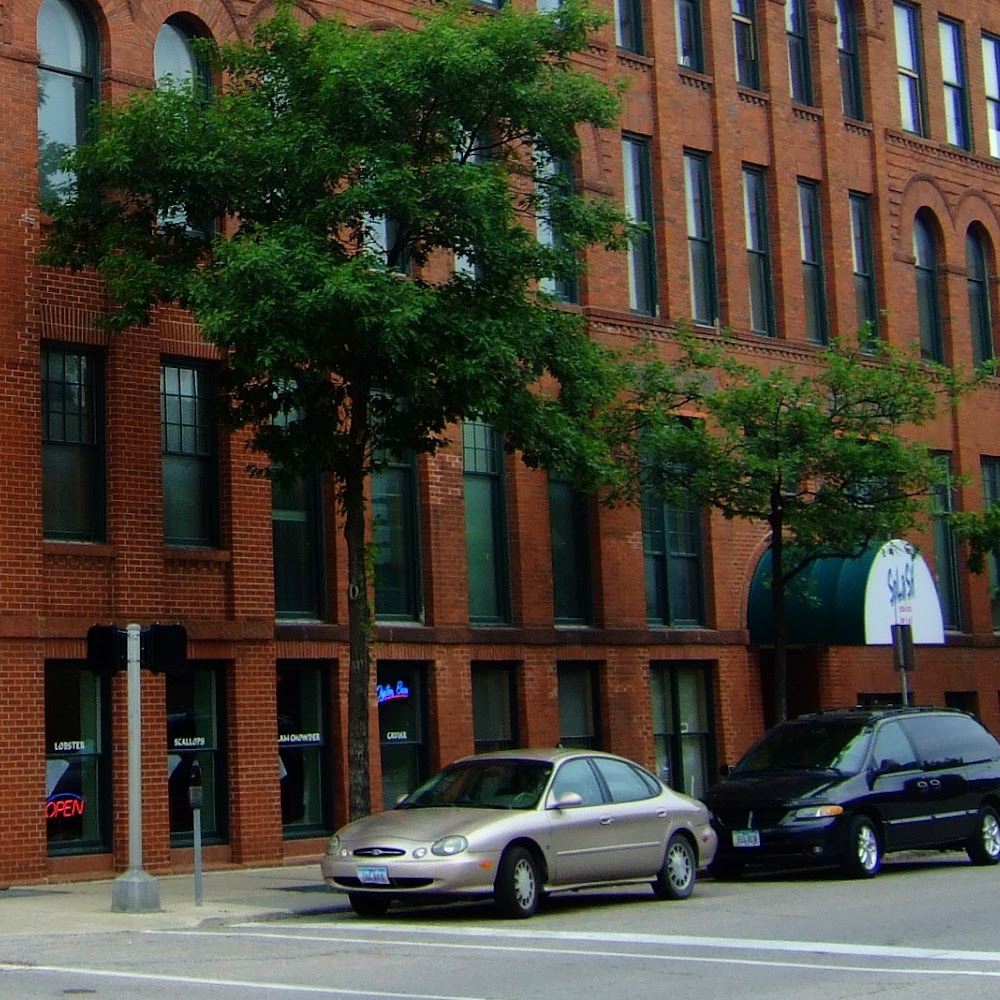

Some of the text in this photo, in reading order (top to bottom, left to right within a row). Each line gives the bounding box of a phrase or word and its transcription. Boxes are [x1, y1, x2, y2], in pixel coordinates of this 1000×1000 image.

[174, 736, 206, 748] SCALLOPS
[290, 732, 321, 743] CHOWDER
[54, 741, 85, 751] LOBSTER
[46, 799, 85, 819] OPEN
